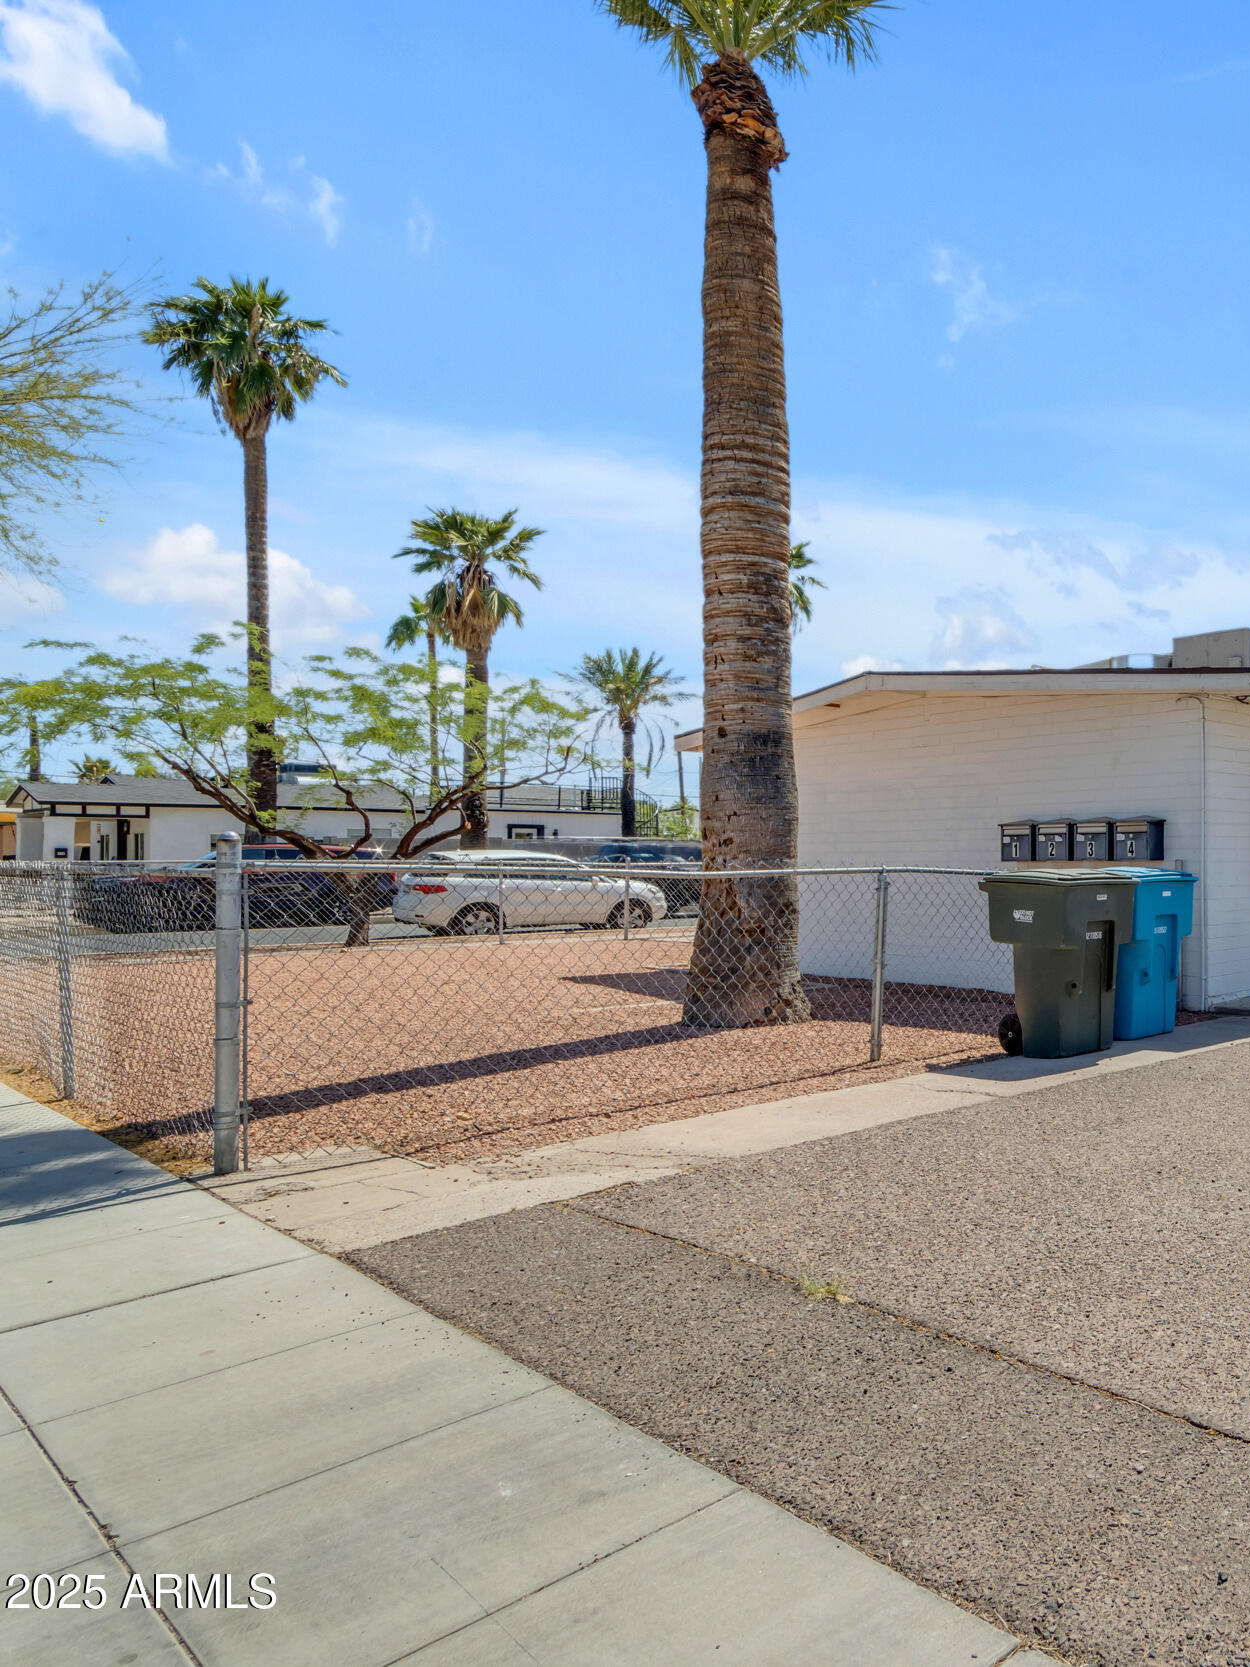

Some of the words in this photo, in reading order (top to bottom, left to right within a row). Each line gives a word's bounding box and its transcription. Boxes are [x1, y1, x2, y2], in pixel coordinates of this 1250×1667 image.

[1049, 842, 1055, 857] 2
[1087, 842, 1094, 857] 3
[1128, 840, 1134, 856] 4
